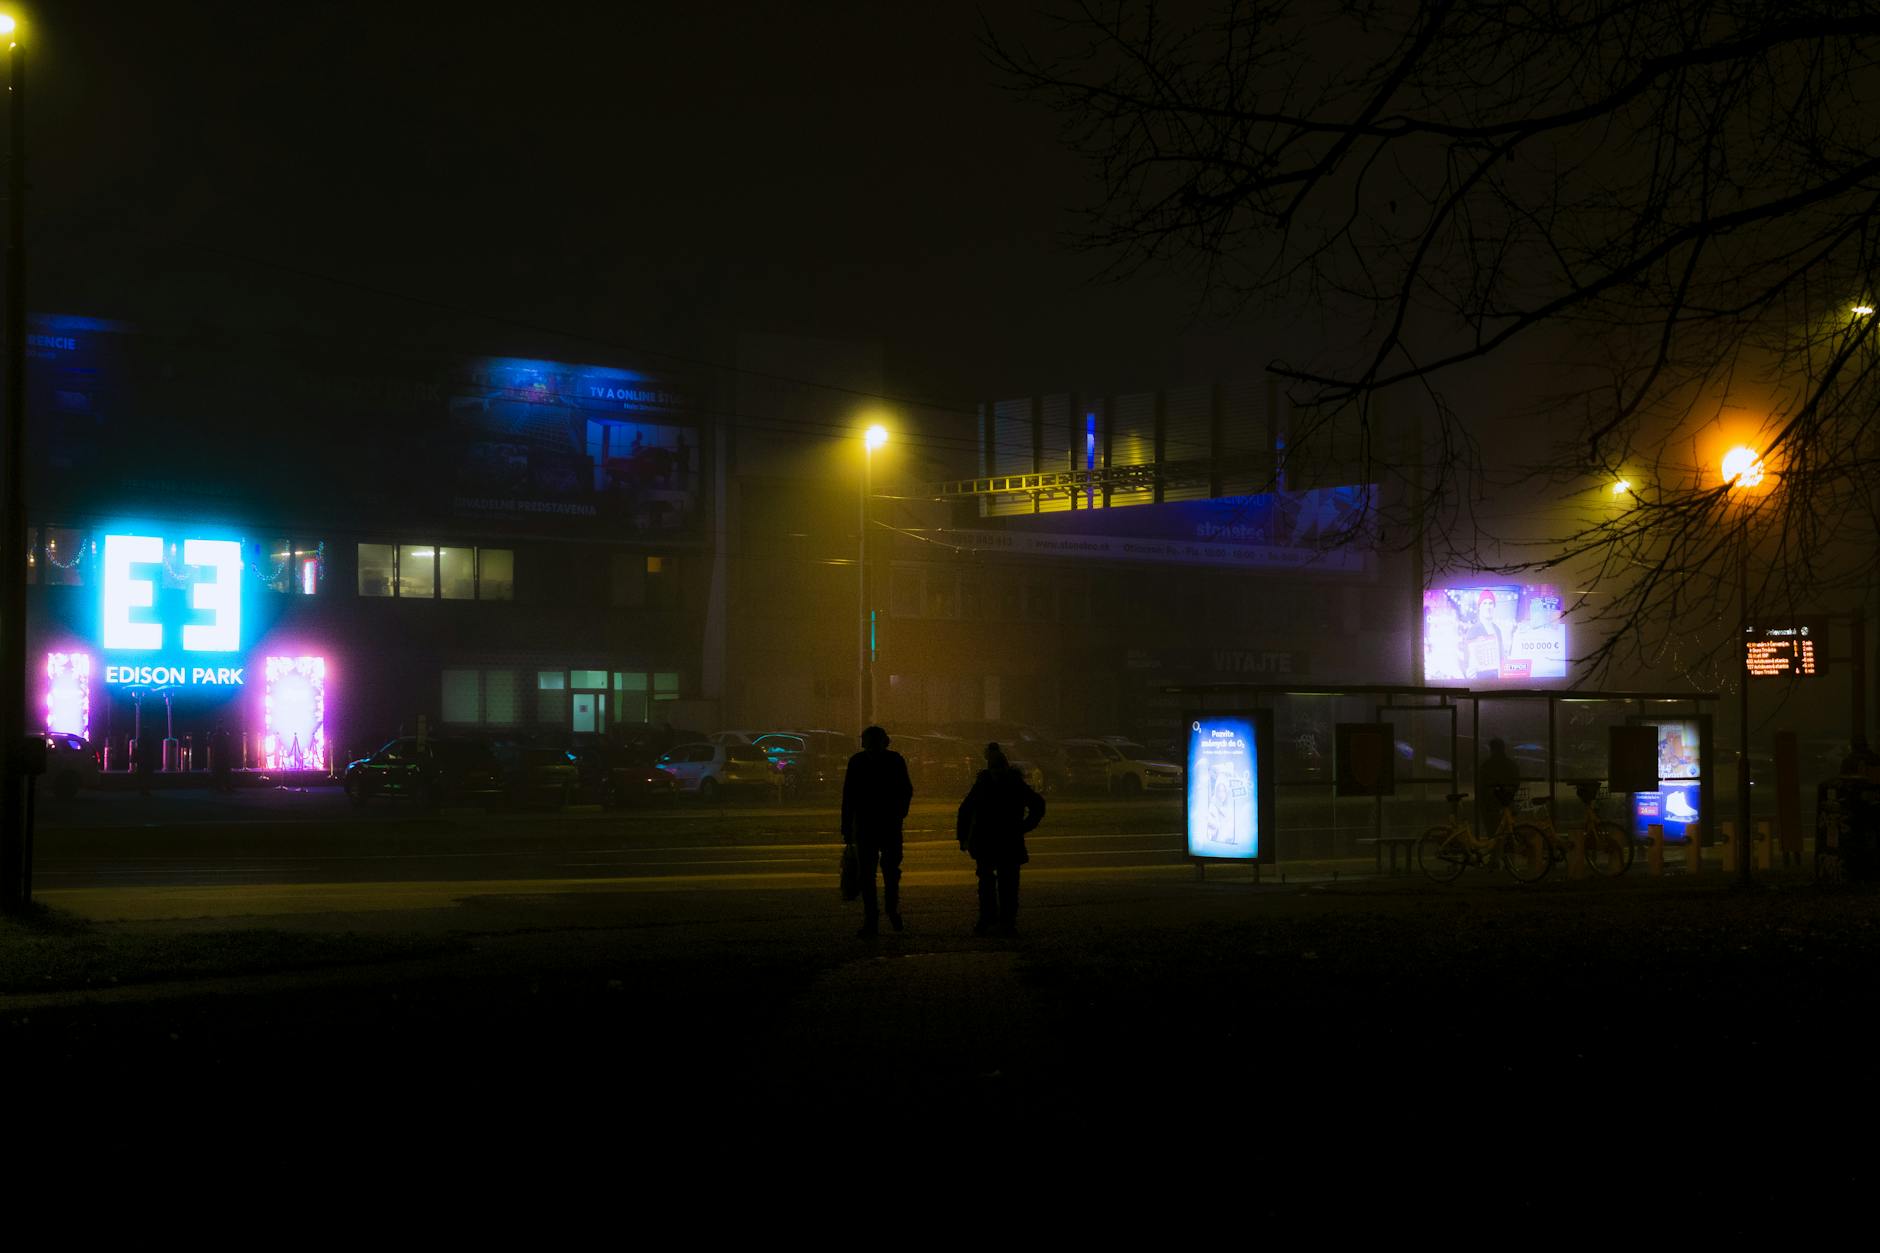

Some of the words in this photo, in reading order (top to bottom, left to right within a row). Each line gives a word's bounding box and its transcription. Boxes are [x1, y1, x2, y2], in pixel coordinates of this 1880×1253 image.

[590, 387, 604, 398] TV
[606, 388, 615, 399] A
[616, 389, 656, 402] ONLINE
[1536, 641, 1552, 650] 000
[1213, 650, 1297, 673] VITAJTE
[106, 666, 186, 684] EDISON
[192, 668, 244, 684] PARK
